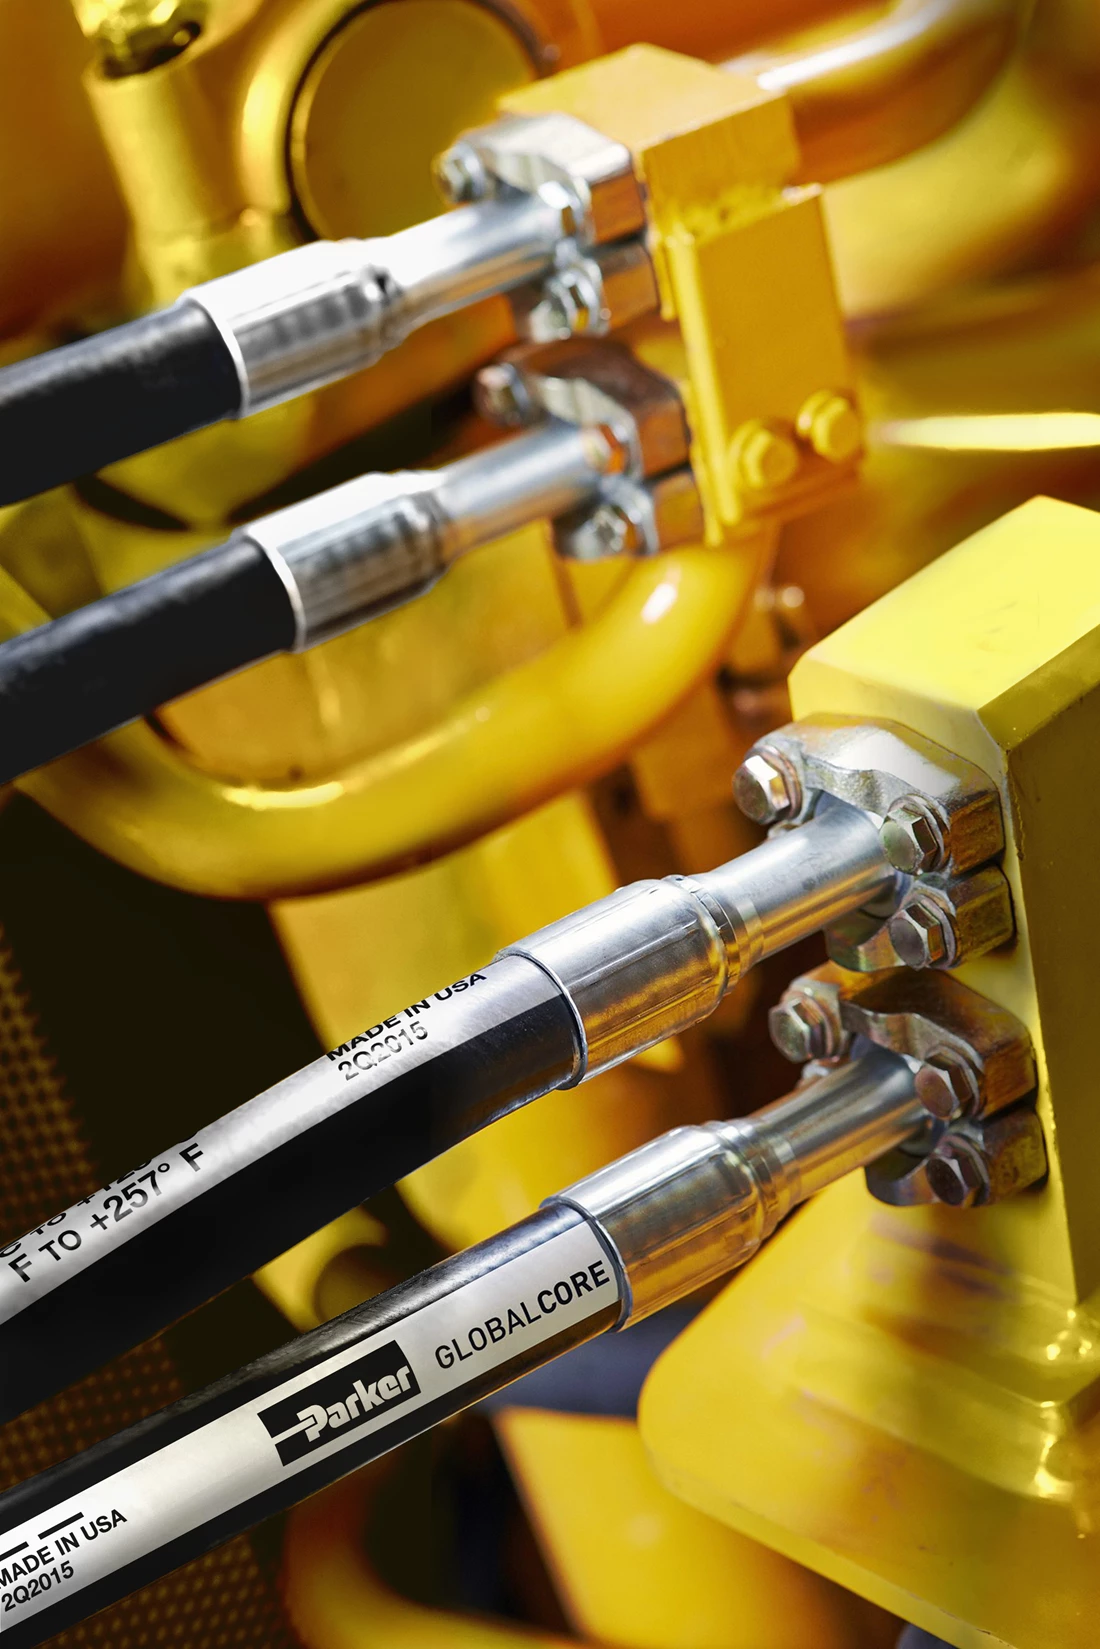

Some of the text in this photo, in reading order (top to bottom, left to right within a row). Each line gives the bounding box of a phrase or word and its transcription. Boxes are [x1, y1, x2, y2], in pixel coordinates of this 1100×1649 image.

[326, 973, 487, 1061] MADE IN USA
[338, 1021, 428, 1081] 2Q2015
[8, 1253, 33, 1283] F
[38, 1230, 82, 1261] TO
[90, 1163, 171, 1231] +257°
[179, 1142, 204, 1172] F
[296, 1260, 611, 1443] Parker GLOBALCORE
[0, 1509, 128, 1589] MADE IN USA
[1, 1560, 74, 1612] 2Q2015
